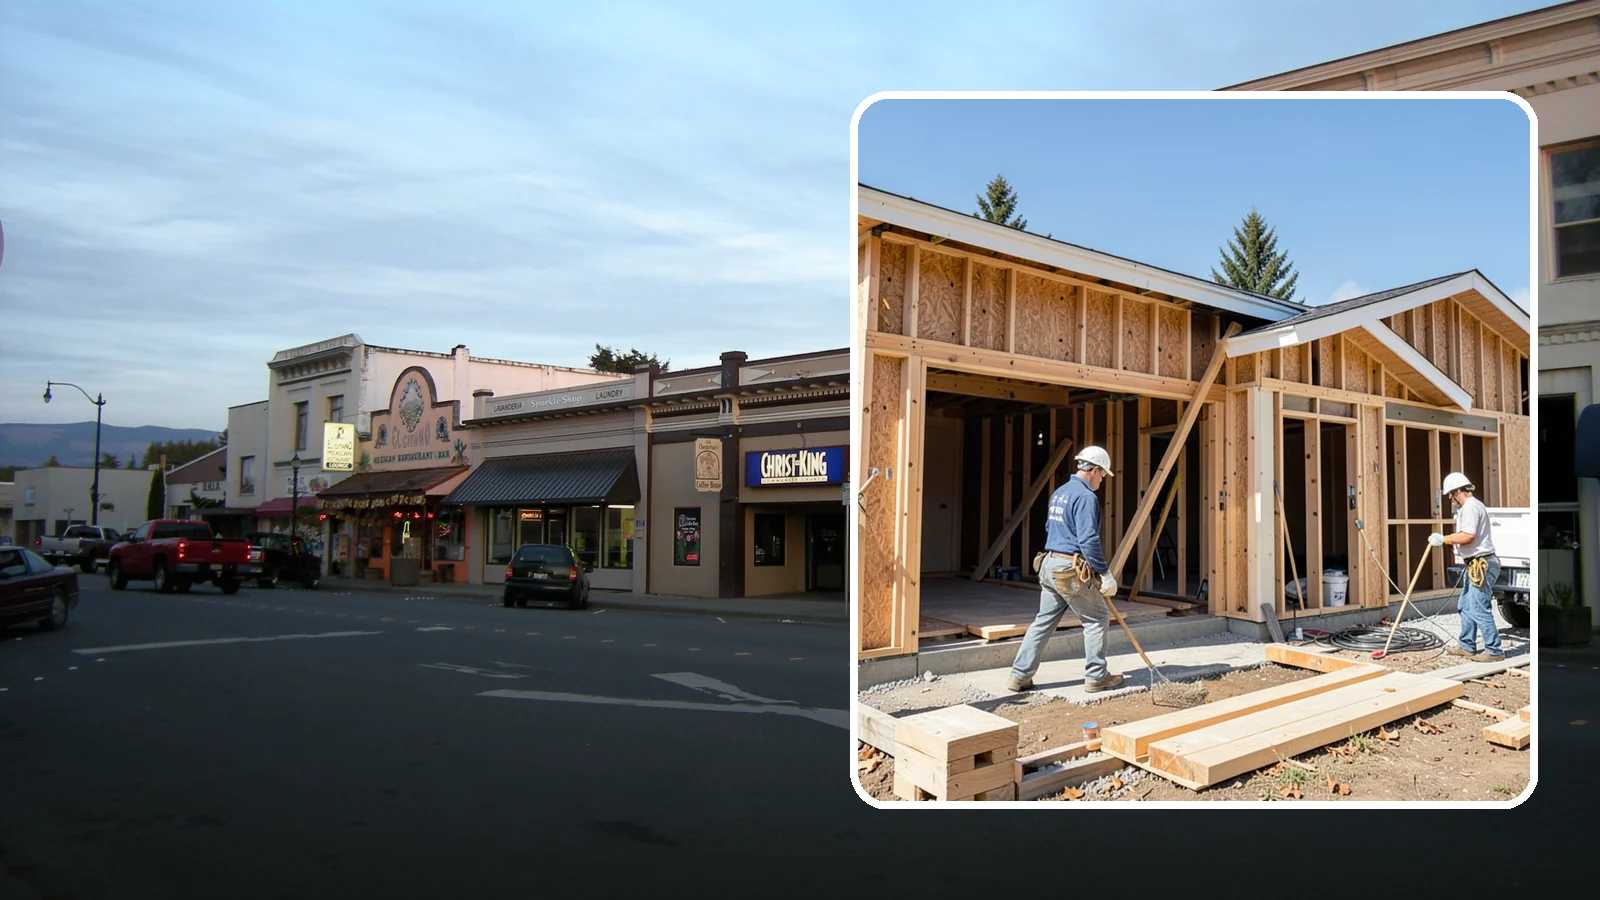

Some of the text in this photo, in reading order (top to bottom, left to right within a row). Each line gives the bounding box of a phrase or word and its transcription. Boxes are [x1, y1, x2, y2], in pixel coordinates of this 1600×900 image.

[596, 389, 623, 400] LAUNDRY
[494, 402, 522, 412] LAVANDERIA
[530, 395, 582, 408] Sparkle Shop
[374, 455, 396, 464] MEXICAN
[397, 451, 433, 462] RESTAURANT
[438, 450, 450, 459] BAR
[761, 450, 827, 478] CHRIST KING
